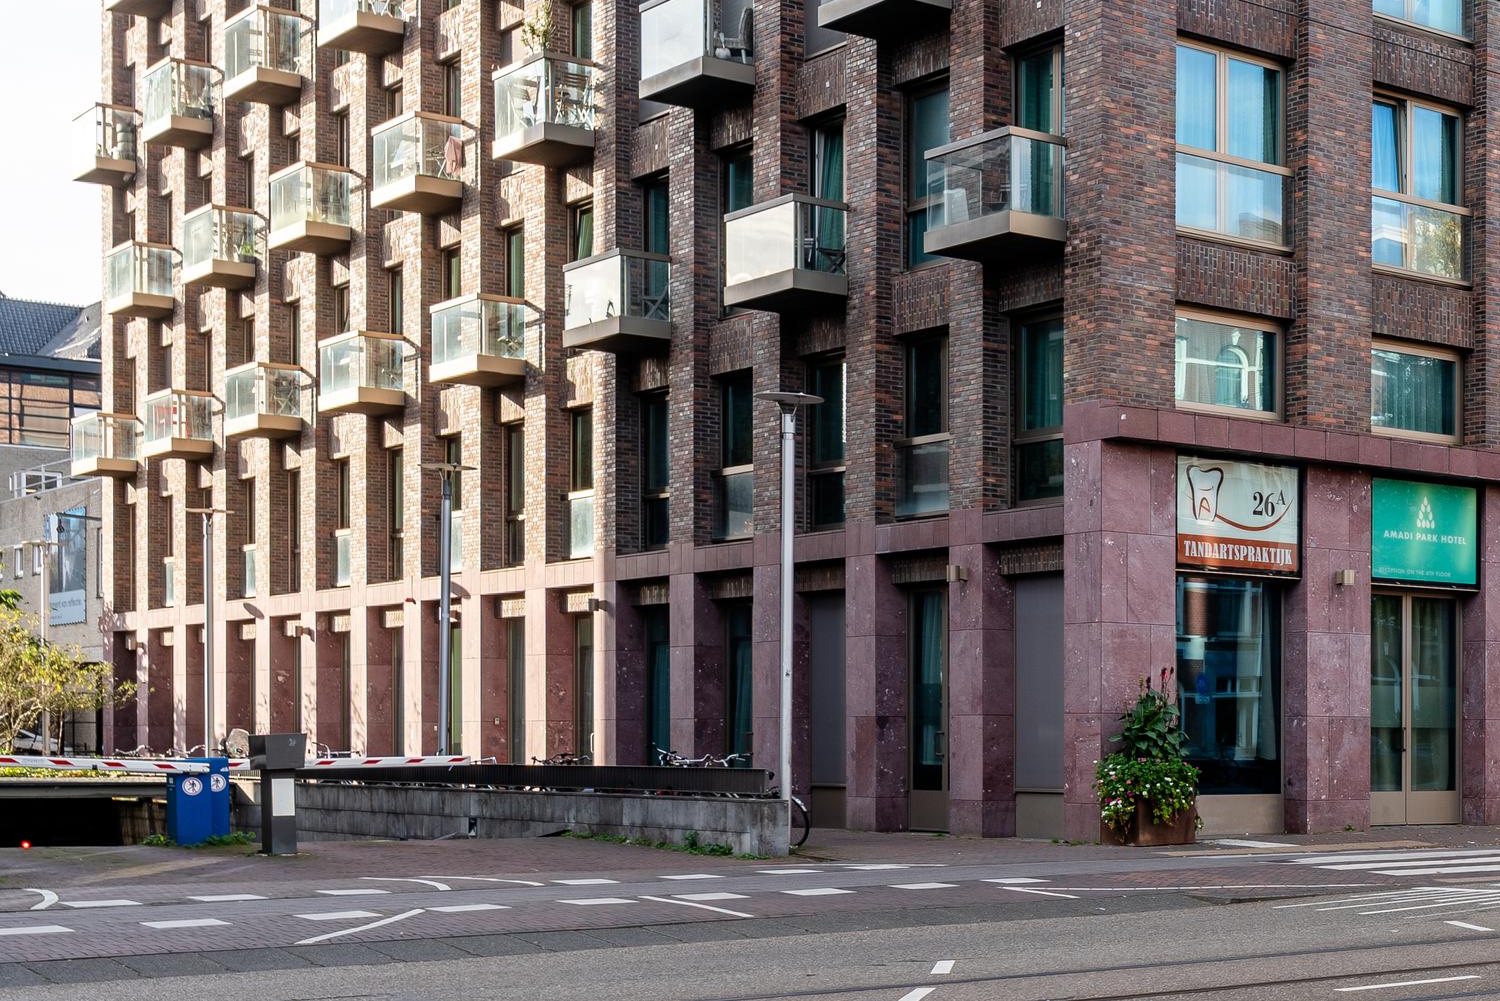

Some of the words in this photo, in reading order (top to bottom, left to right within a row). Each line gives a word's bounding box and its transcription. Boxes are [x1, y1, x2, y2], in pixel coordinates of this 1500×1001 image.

[1383, 529, 1414, 541] AMADI
[1416, 533, 1439, 543] PARK
[1440, 535, 1467, 545] HOTEL
[1183, 540, 1293, 566] TANDARTSPRAKTIJK
